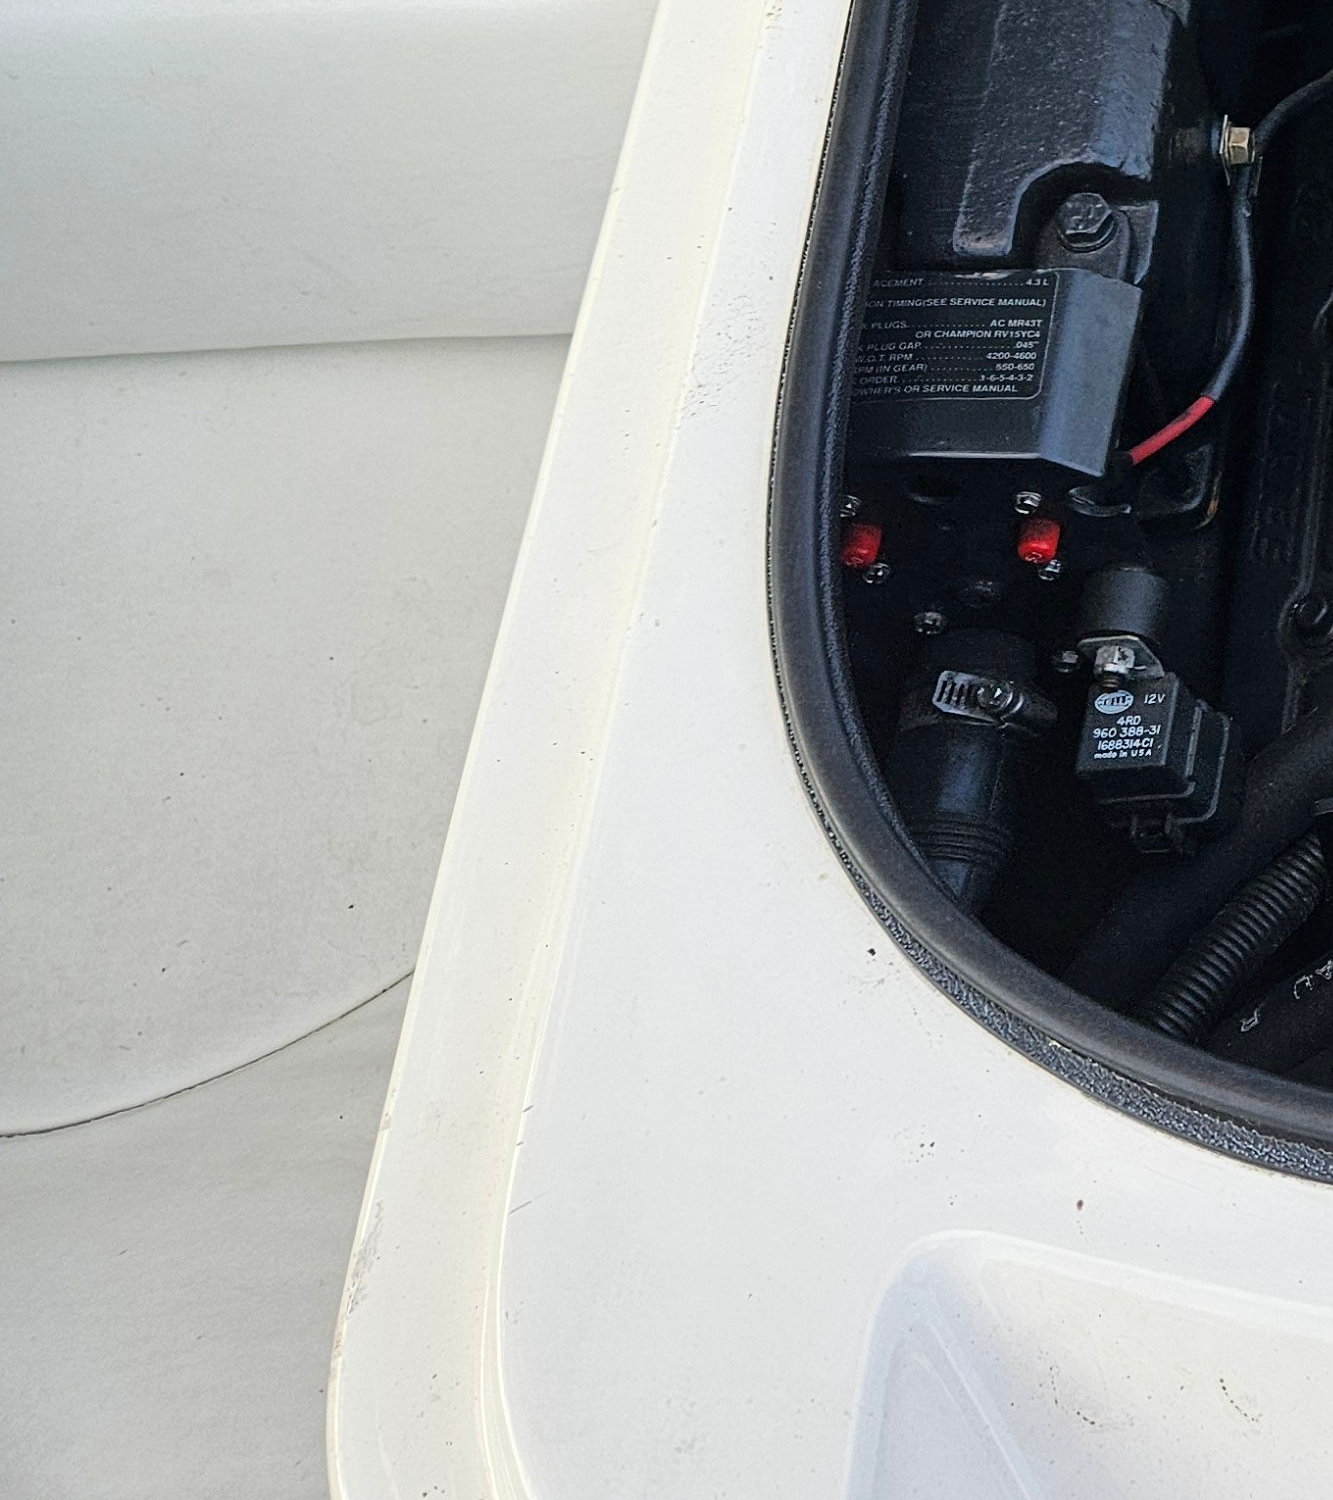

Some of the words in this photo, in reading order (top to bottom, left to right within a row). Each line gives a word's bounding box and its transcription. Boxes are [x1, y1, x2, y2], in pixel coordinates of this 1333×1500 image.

[949, 298, 996, 306] SERVICE
[998, 298, 1046, 307] MANUAL)
[989, 319, 1006, 328] AC
[1008, 319, 1043, 328] MR43T
[915, 330, 932, 339] OR
[934, 330, 991, 339] CHAMPION
[889, 353, 913, 362] RPM
[986, 352, 1037, 360] 4200-4600
[904, 385, 919, 393] OR
[922, 385, 970, 393] SERVICE
[972, 384, 1018, 393] MANUAL
[1144, 693, 1167, 705] 12V
[1116, 715, 1142, 726] 4RD
[1092, 727, 1117, 738] 960
[1094, 750, 1118, 760] made
[1119, 750, 1128, 758] in
